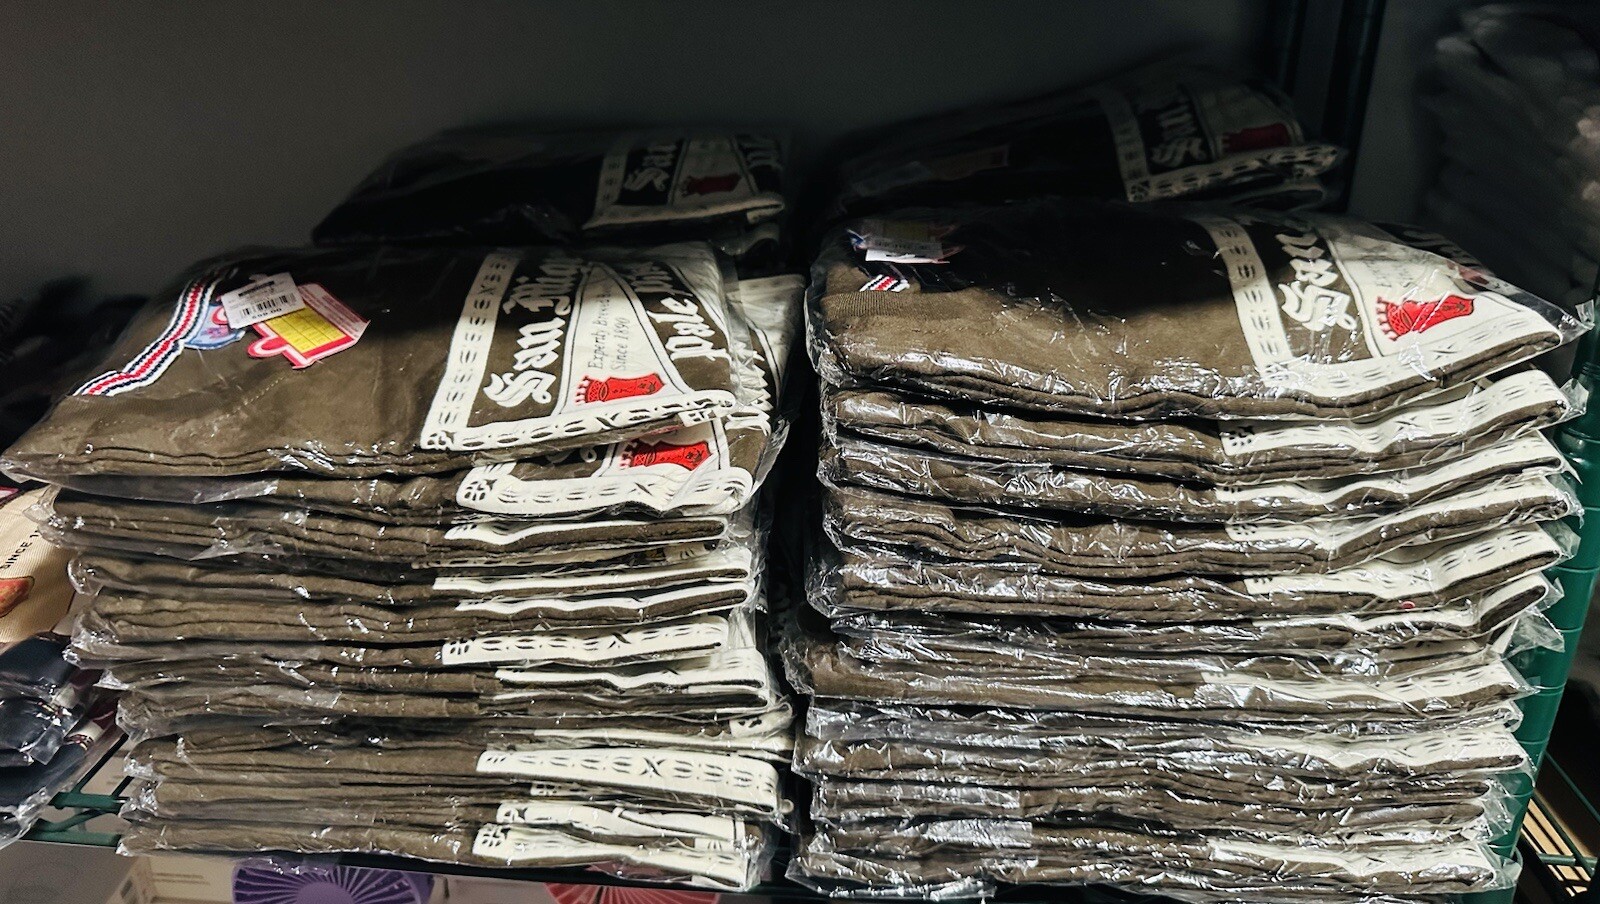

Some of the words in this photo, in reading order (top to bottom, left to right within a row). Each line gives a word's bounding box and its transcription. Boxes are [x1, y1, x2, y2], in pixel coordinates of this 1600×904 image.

[1275, 231, 1358, 332] San
[483, 316, 566, 408] San
[611, 343, 628, 372] Since
[646, 296, 732, 362] Pale
